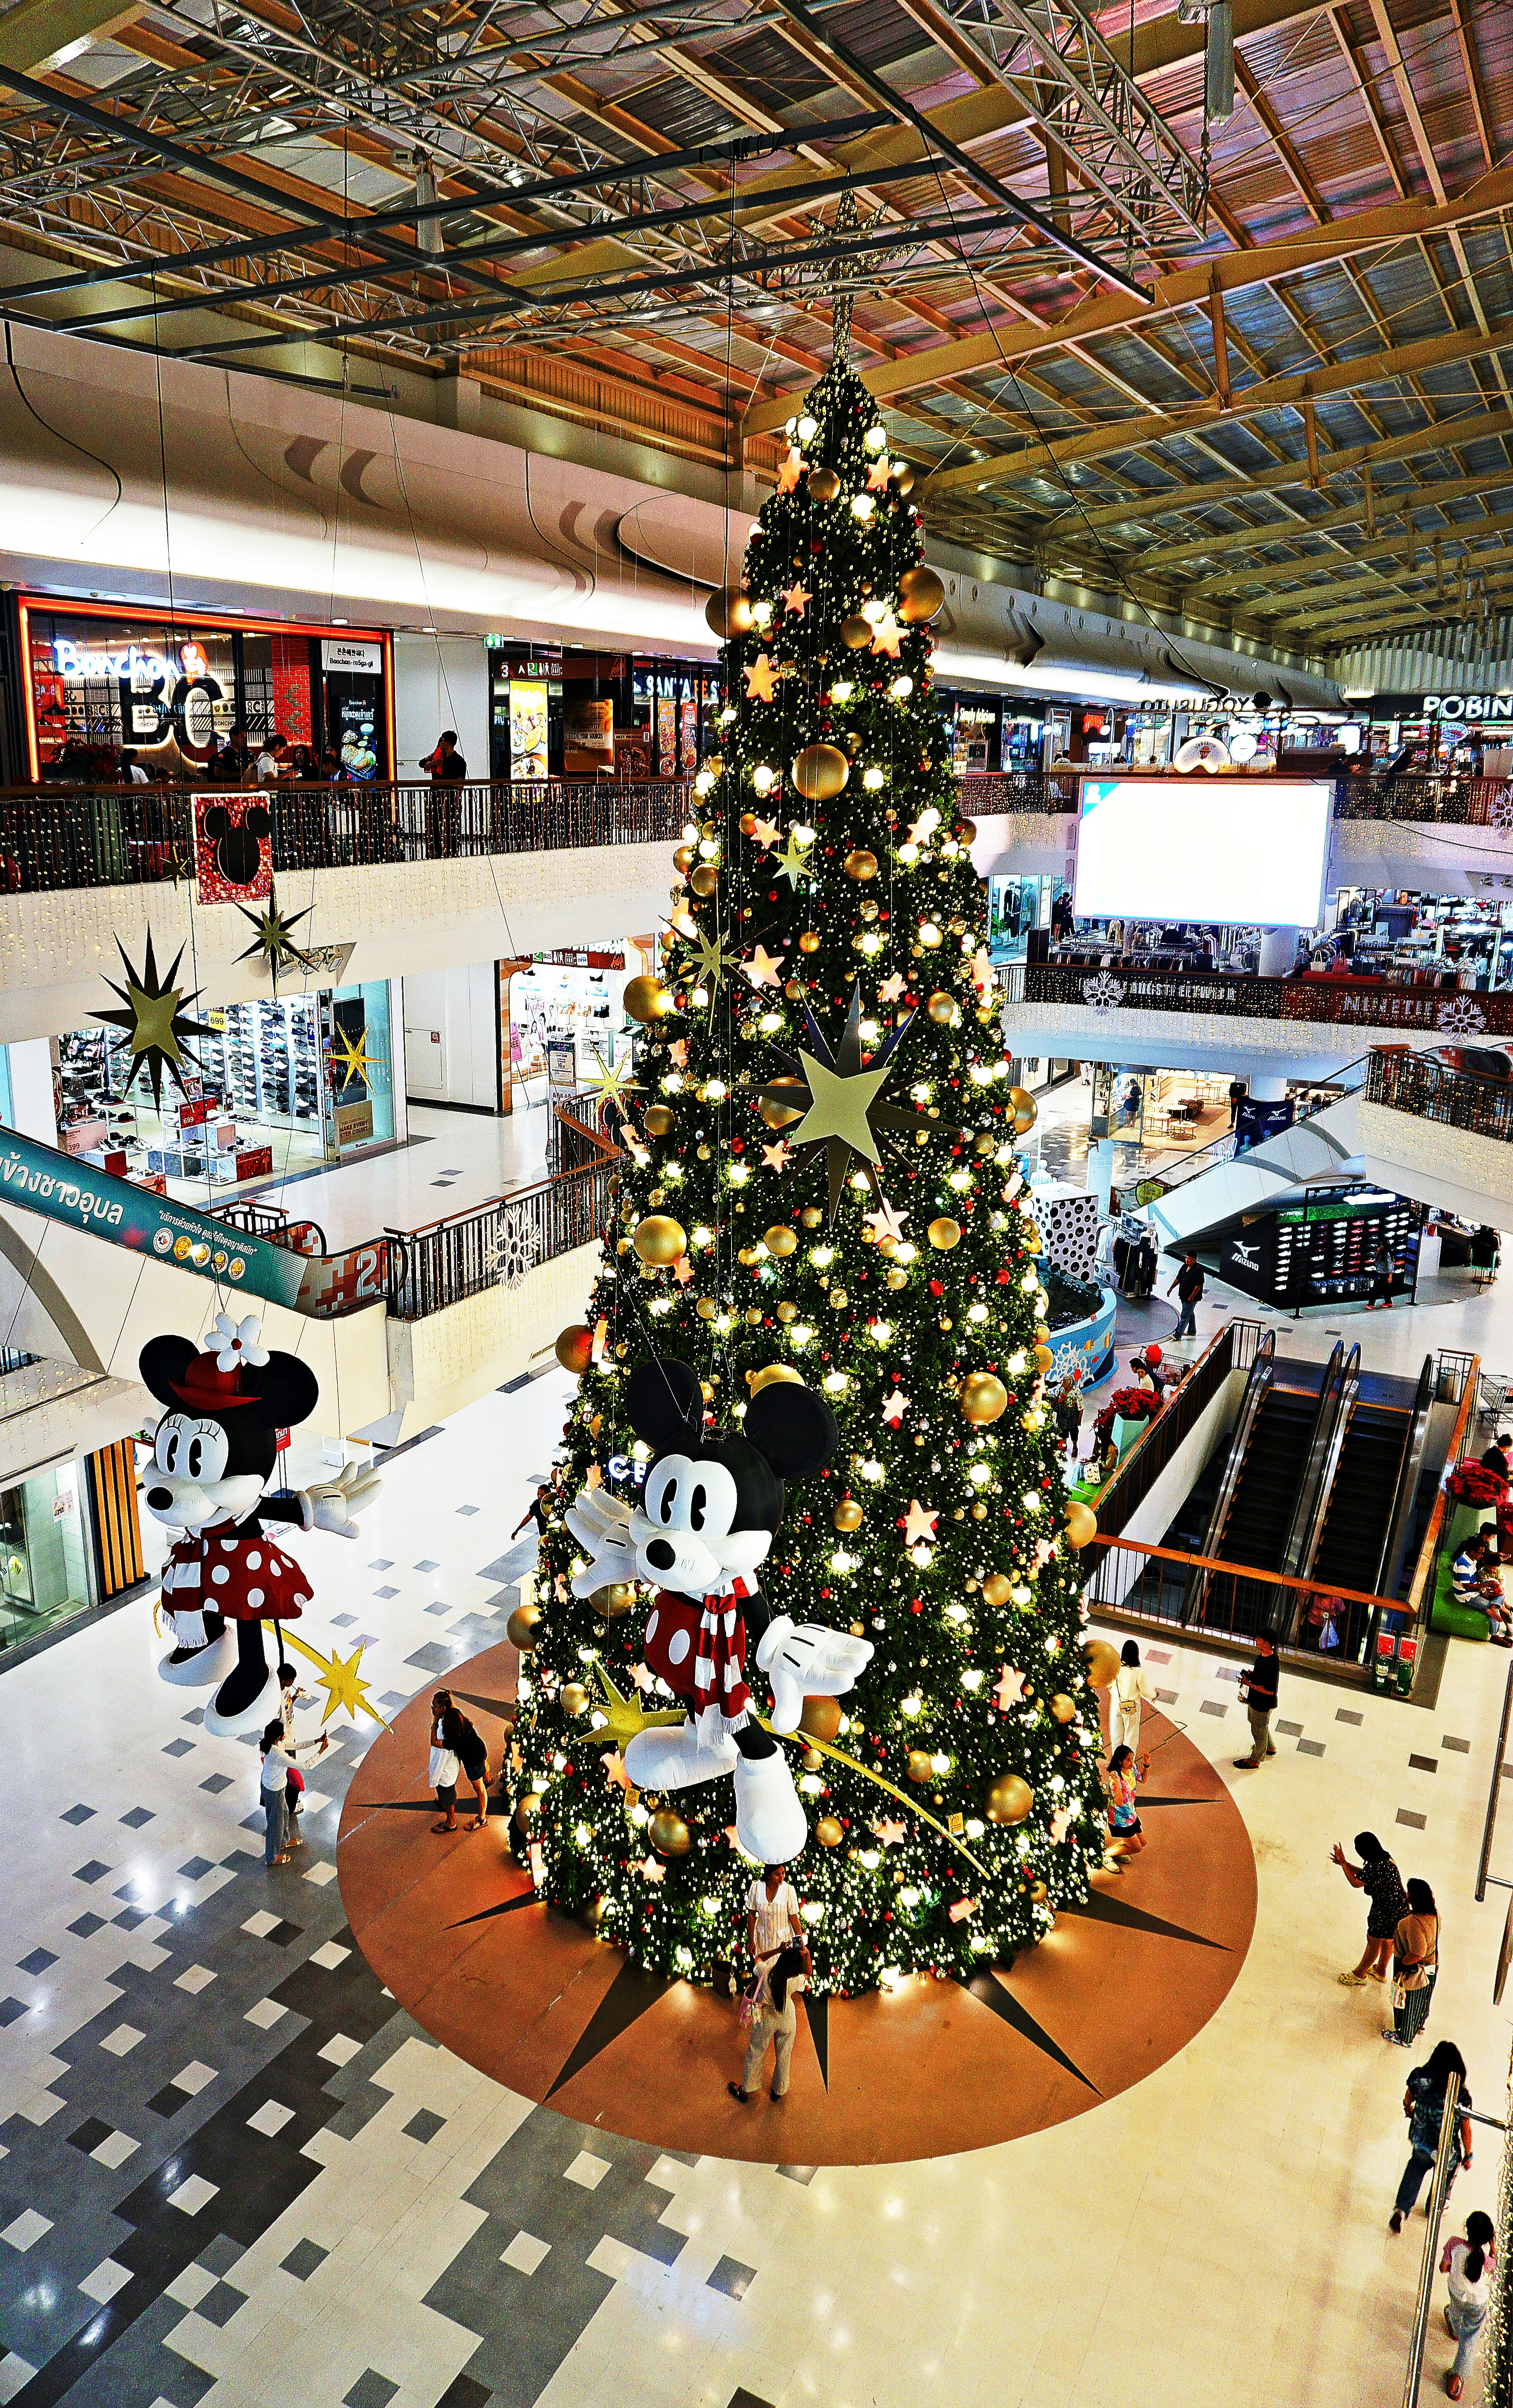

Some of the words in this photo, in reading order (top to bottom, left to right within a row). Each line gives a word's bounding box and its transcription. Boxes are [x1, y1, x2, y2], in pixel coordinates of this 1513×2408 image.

[53, 639, 181, 680] Bonchon
[501, 665, 508, 677] 3
[710, 680, 720, 699] S
[211, 1017, 224, 1025] 699
[510, 1040, 519, 1048] REE
[339, 1124, 353, 1132] MAKE
[353, 1120, 368, 1128] EVERY
[352, 1125, 368, 1135] COUNT
